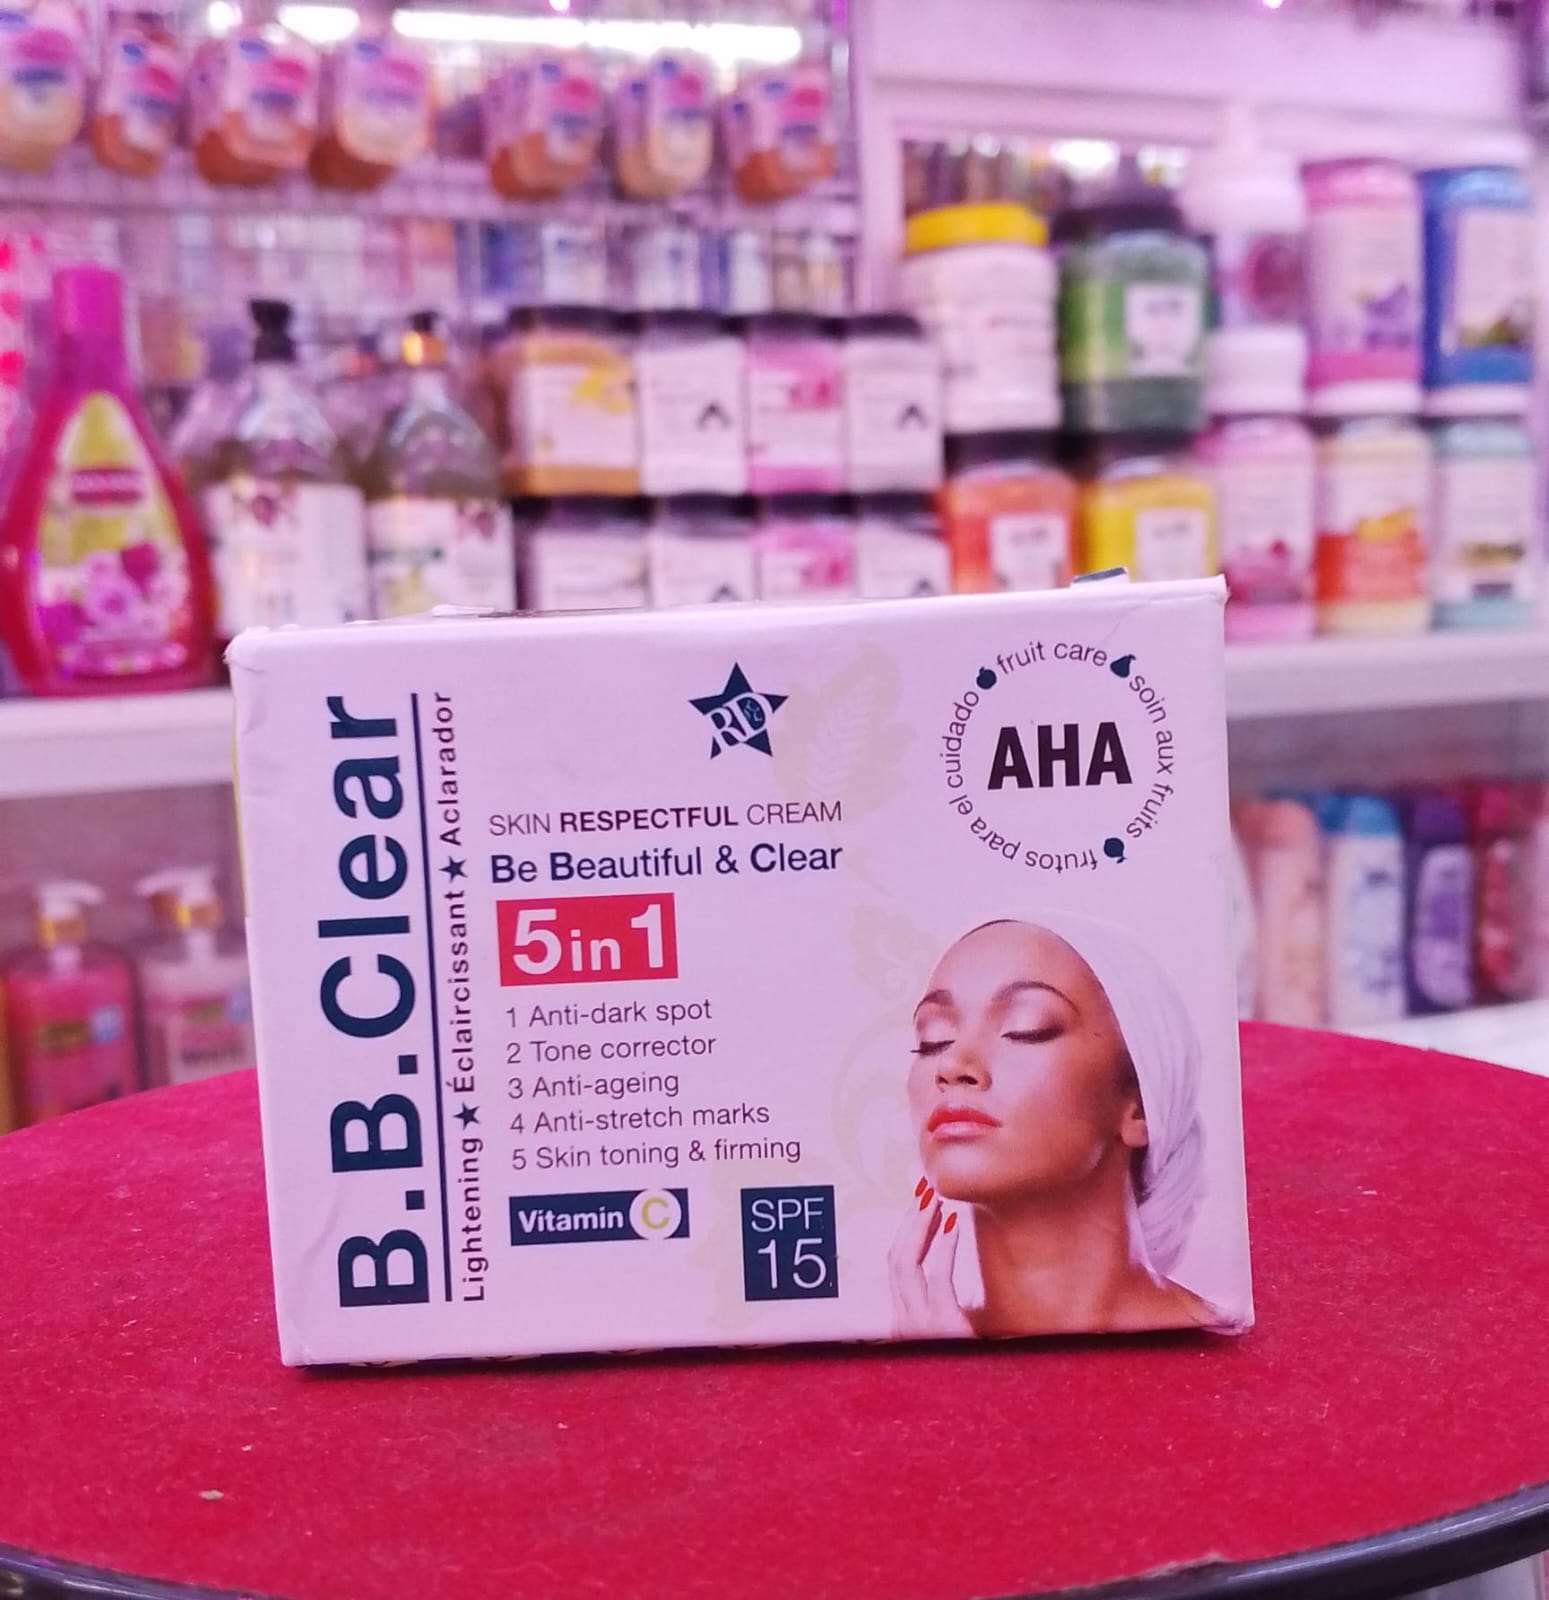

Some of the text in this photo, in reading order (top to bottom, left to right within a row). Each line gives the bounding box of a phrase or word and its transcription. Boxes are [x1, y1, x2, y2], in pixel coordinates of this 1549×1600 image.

[997, 641, 1108, 675] fruit care
[987, 722, 1133, 790] AHA
[1127, 675, 1174, 838] soin aux fruits
[940, 691, 1098, 874] frutos para el cuidado
[489, 801, 842, 836] SKIN RESPECTFUL CREAM
[490, 842, 843, 883] Be Beautiful & Clear
[317, 695, 431, 1307] B.B.Clear
[432, 692, 488, 1302] Lightening Éclaircissant Aclarador
[506, 999, 712, 1028] 1 Anti-dark spot
[507, 1035, 716, 1064] 2 Tone corrector
[508, 1073, 680, 1100] 3 Anti-ageing
[510, 1103, 770, 1134] 4 Anti-stretch marks
[512, 1138, 801, 1170] 5 Skin toning & firming
[517, 1197, 670, 1234] Vitamin C
[751, 1197, 824, 1232] SPF
[757, 1238, 827, 1289] 15
